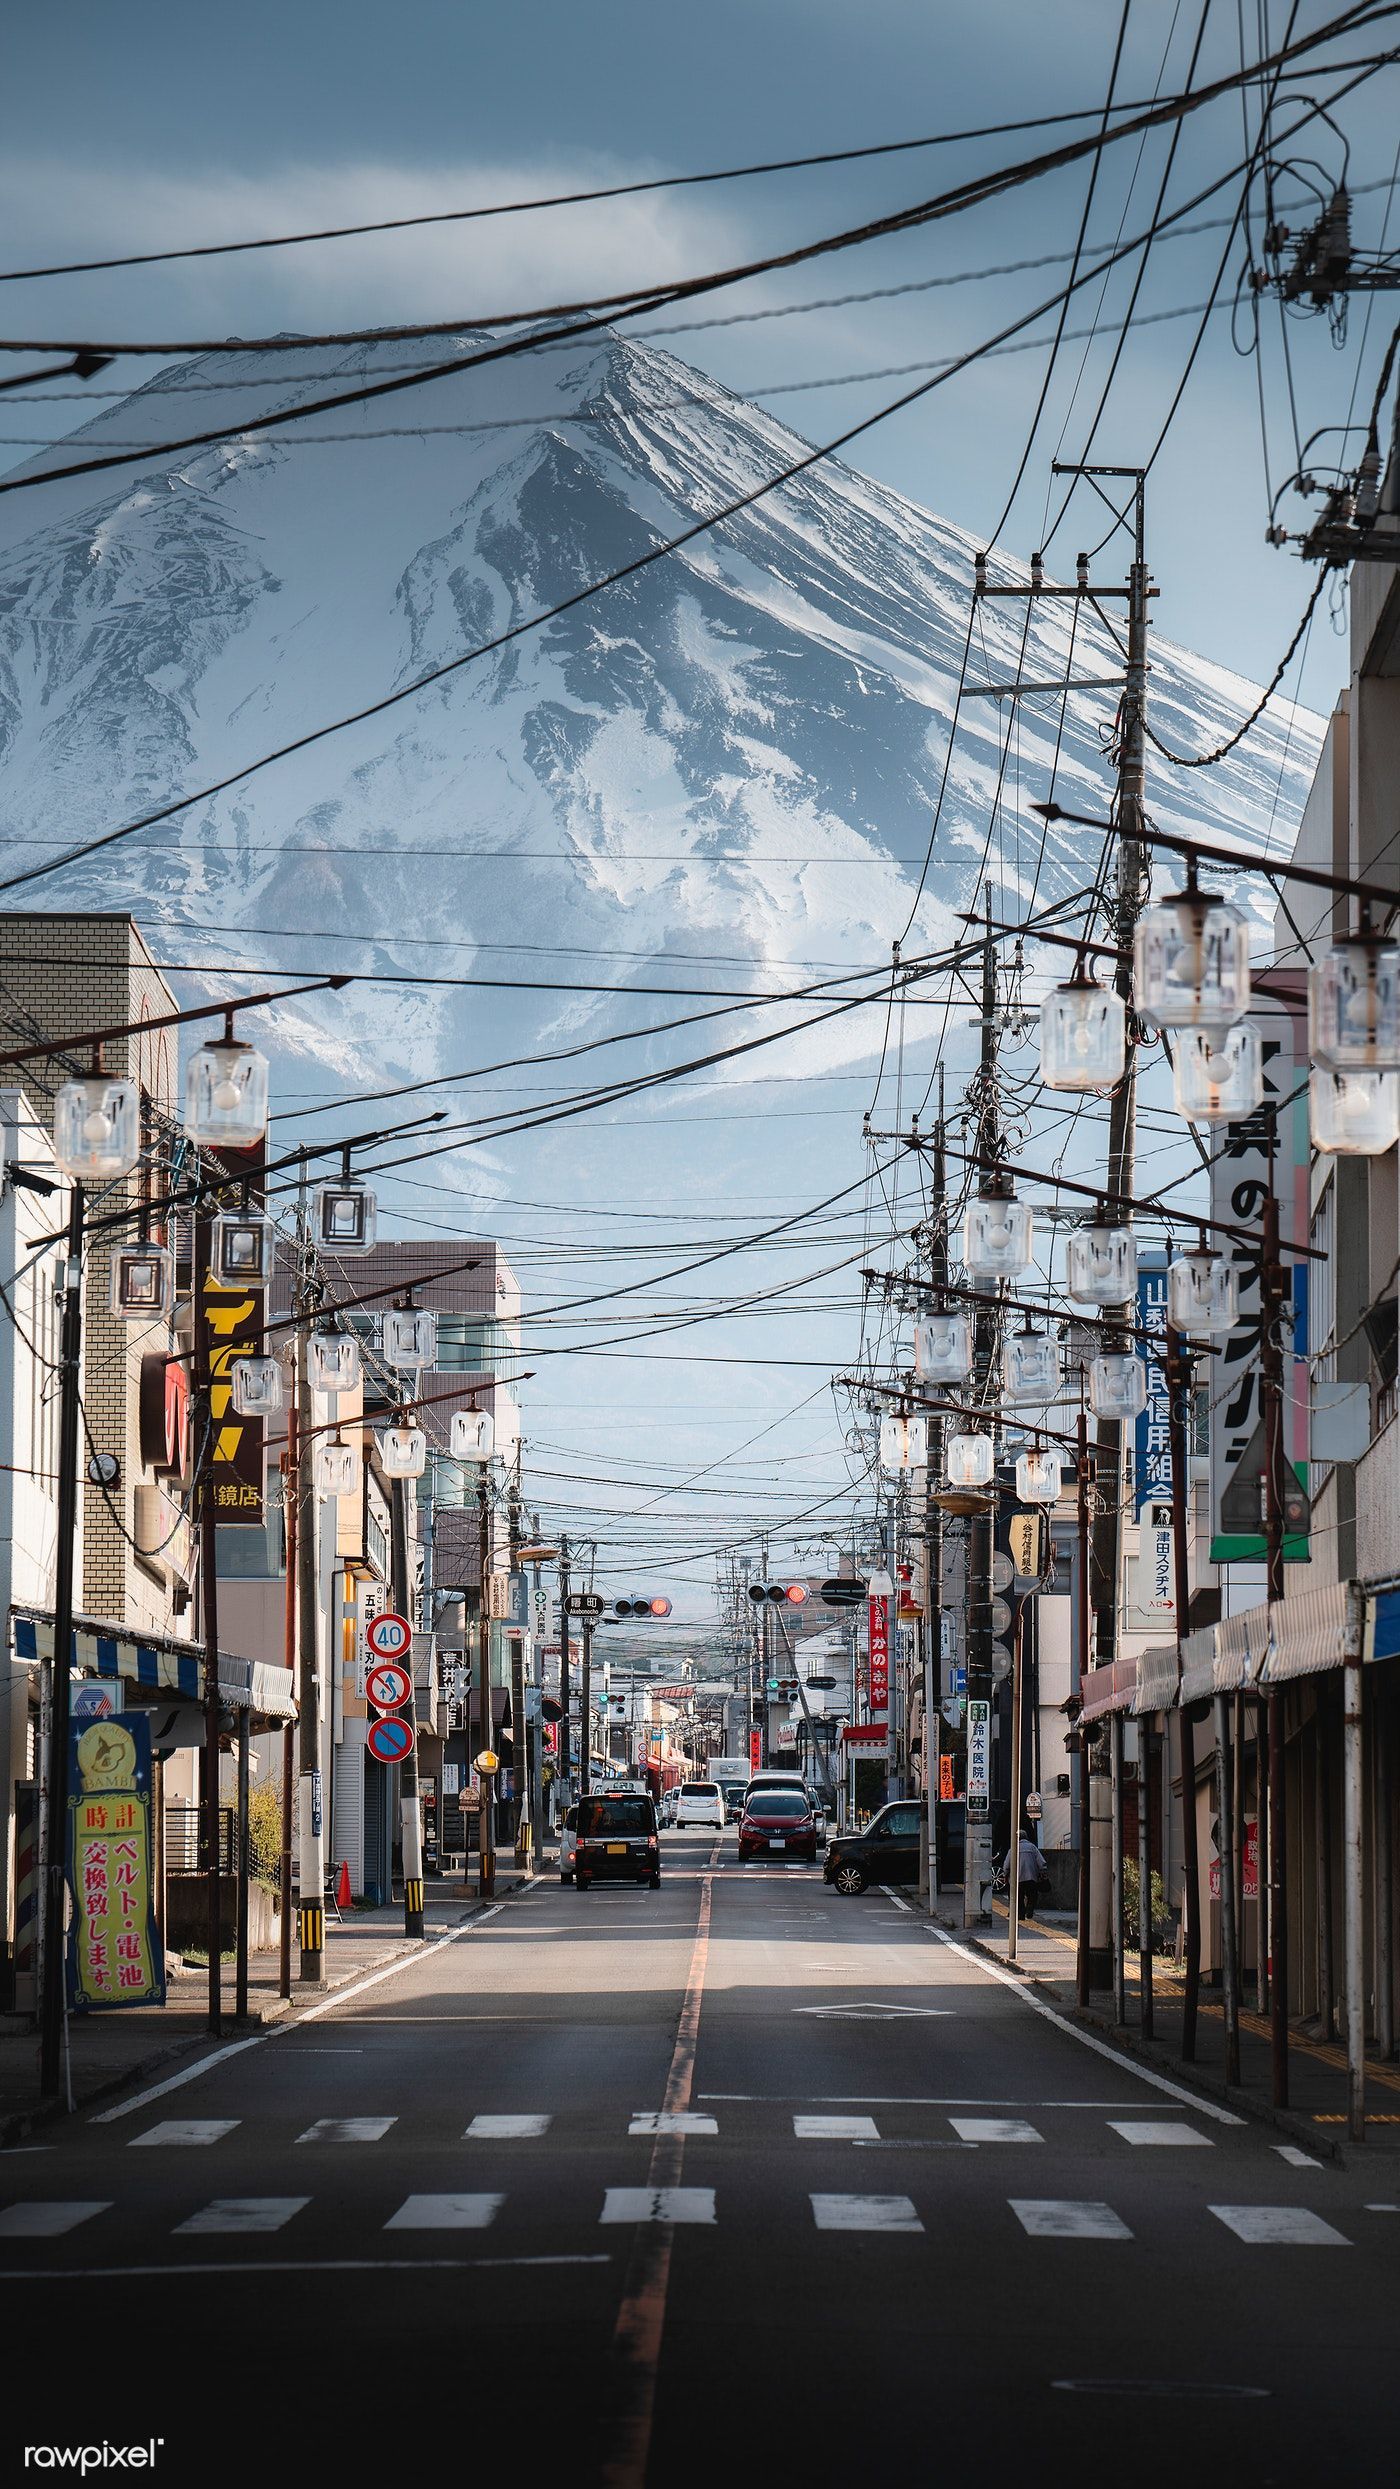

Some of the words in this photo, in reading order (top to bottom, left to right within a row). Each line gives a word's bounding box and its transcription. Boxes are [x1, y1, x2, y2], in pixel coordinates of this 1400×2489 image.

[1155, 1531, 1170, 1597] 津田スタヂオ
[377, 1626, 402, 1647] 40
[972, 1722, 985, 1779] 鈴木医院
[85, 1774, 133, 1790] BAMBI
[86, 1804, 136, 1829] 時計
[83, 1841, 112, 1993] 交換致します。
[114, 1839, 145, 1989] ベルト・電池
